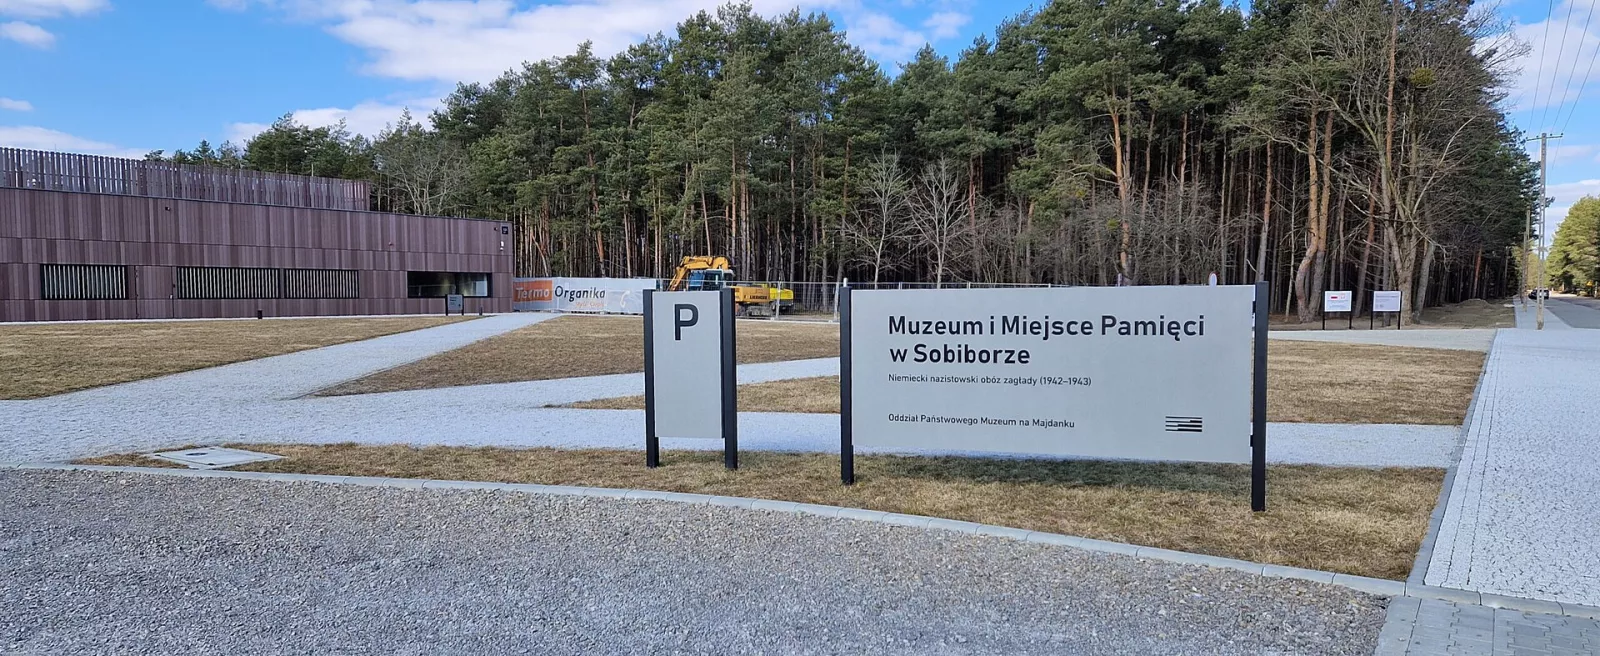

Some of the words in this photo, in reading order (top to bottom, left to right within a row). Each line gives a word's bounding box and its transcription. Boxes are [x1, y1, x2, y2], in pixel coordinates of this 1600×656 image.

[516, 287, 550, 299] Termo
[554, 285, 606, 302] Organika
[674, 303, 699, 341] P
[888, 315, 983, 336] Muzeum
[990, 315, 995, 335] i
[1001, 315, 1094, 341] Miejsce
[1101, 314, 1205, 342] Pamięci
[889, 348, 908, 363] w
[913, 343, 1031, 365] Sobiborze
[888, 373, 928, 383] Niemiecki
[930, 375, 979, 384] nazistowski
[980, 375, 1001, 384] obóz
[1003, 376, 1038, 387] zagłady
[888, 413, 919, 423] Oddział
[920, 414, 979, 427] Państwowego
[980, 416, 1017, 426] Muzeum
[1019, 419, 1030, 427] na
[1032, 418, 1075, 429] Majdanku
